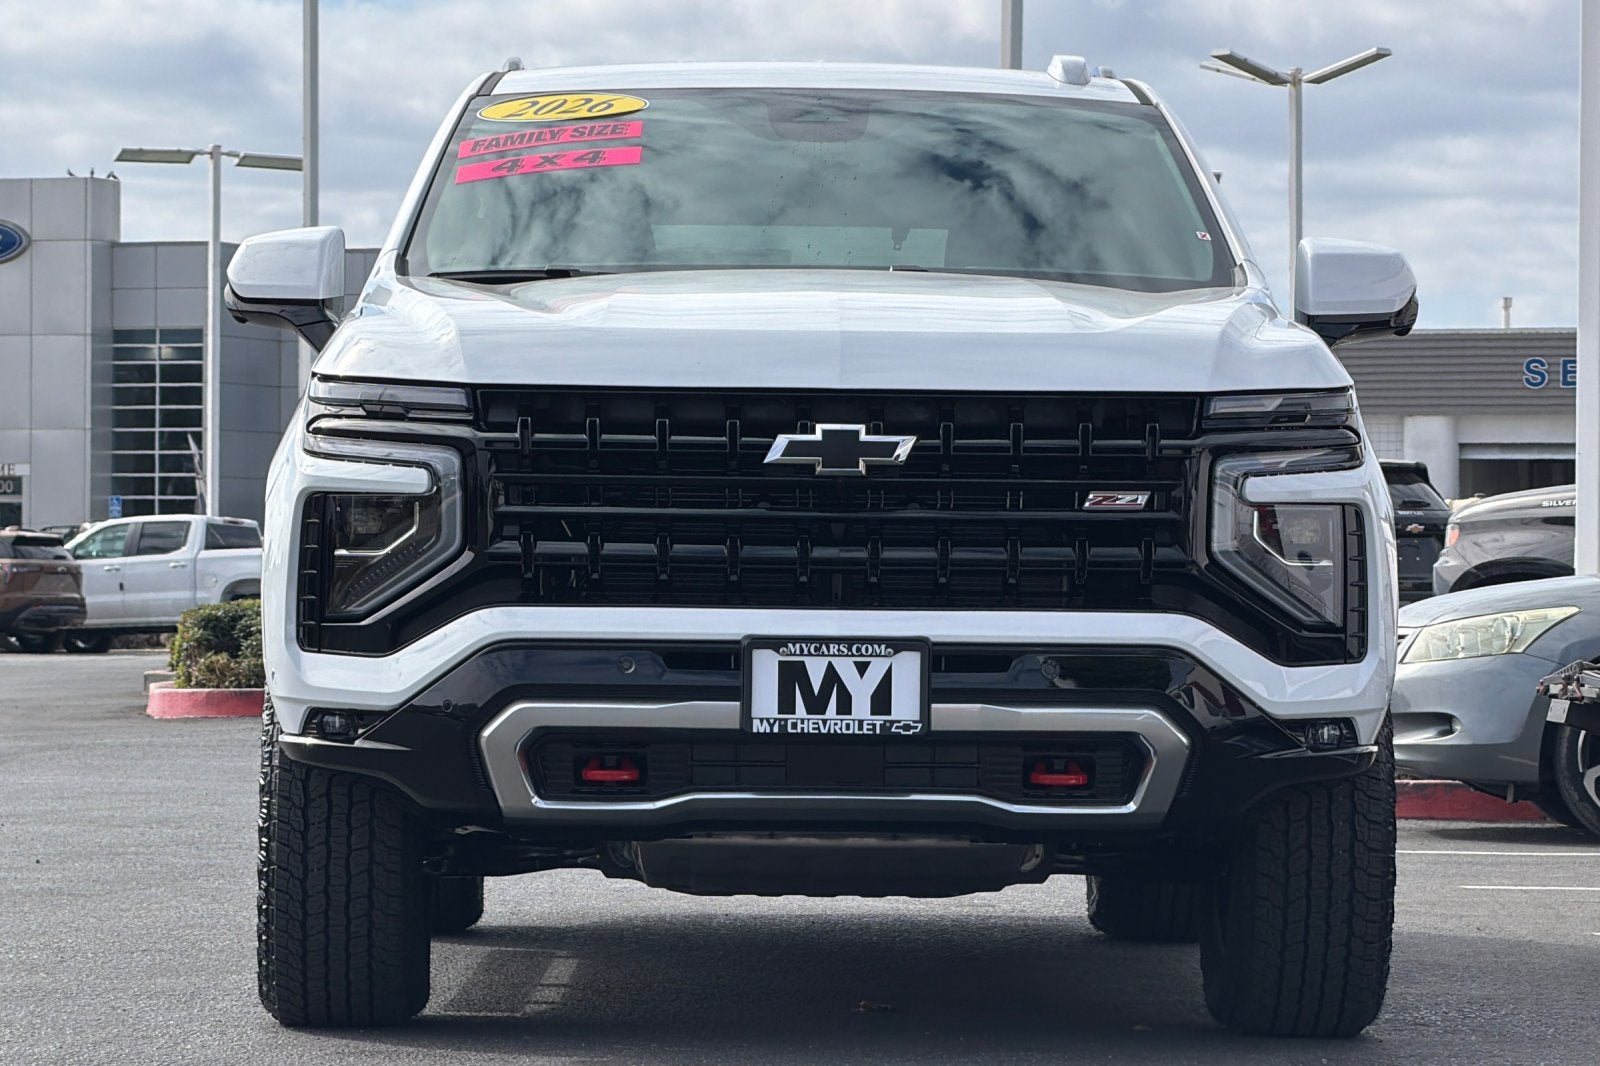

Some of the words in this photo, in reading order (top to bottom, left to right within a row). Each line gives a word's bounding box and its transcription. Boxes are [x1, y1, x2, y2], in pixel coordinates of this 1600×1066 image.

[501, 97, 626, 118] 2026
[470, 127, 568, 153] FAMILY
[569, 123, 631, 139] SIZE
[491, 157, 526, 174] 4
[572, 149, 607, 165] 4
[1083, 493, 1149, 508] Z71
[786, 643, 887, 656] MYCARS.COM
[777, 660, 892, 716] MY
[752, 719, 780, 733] MY
[787, 720, 884, 734] CHEVROLET
